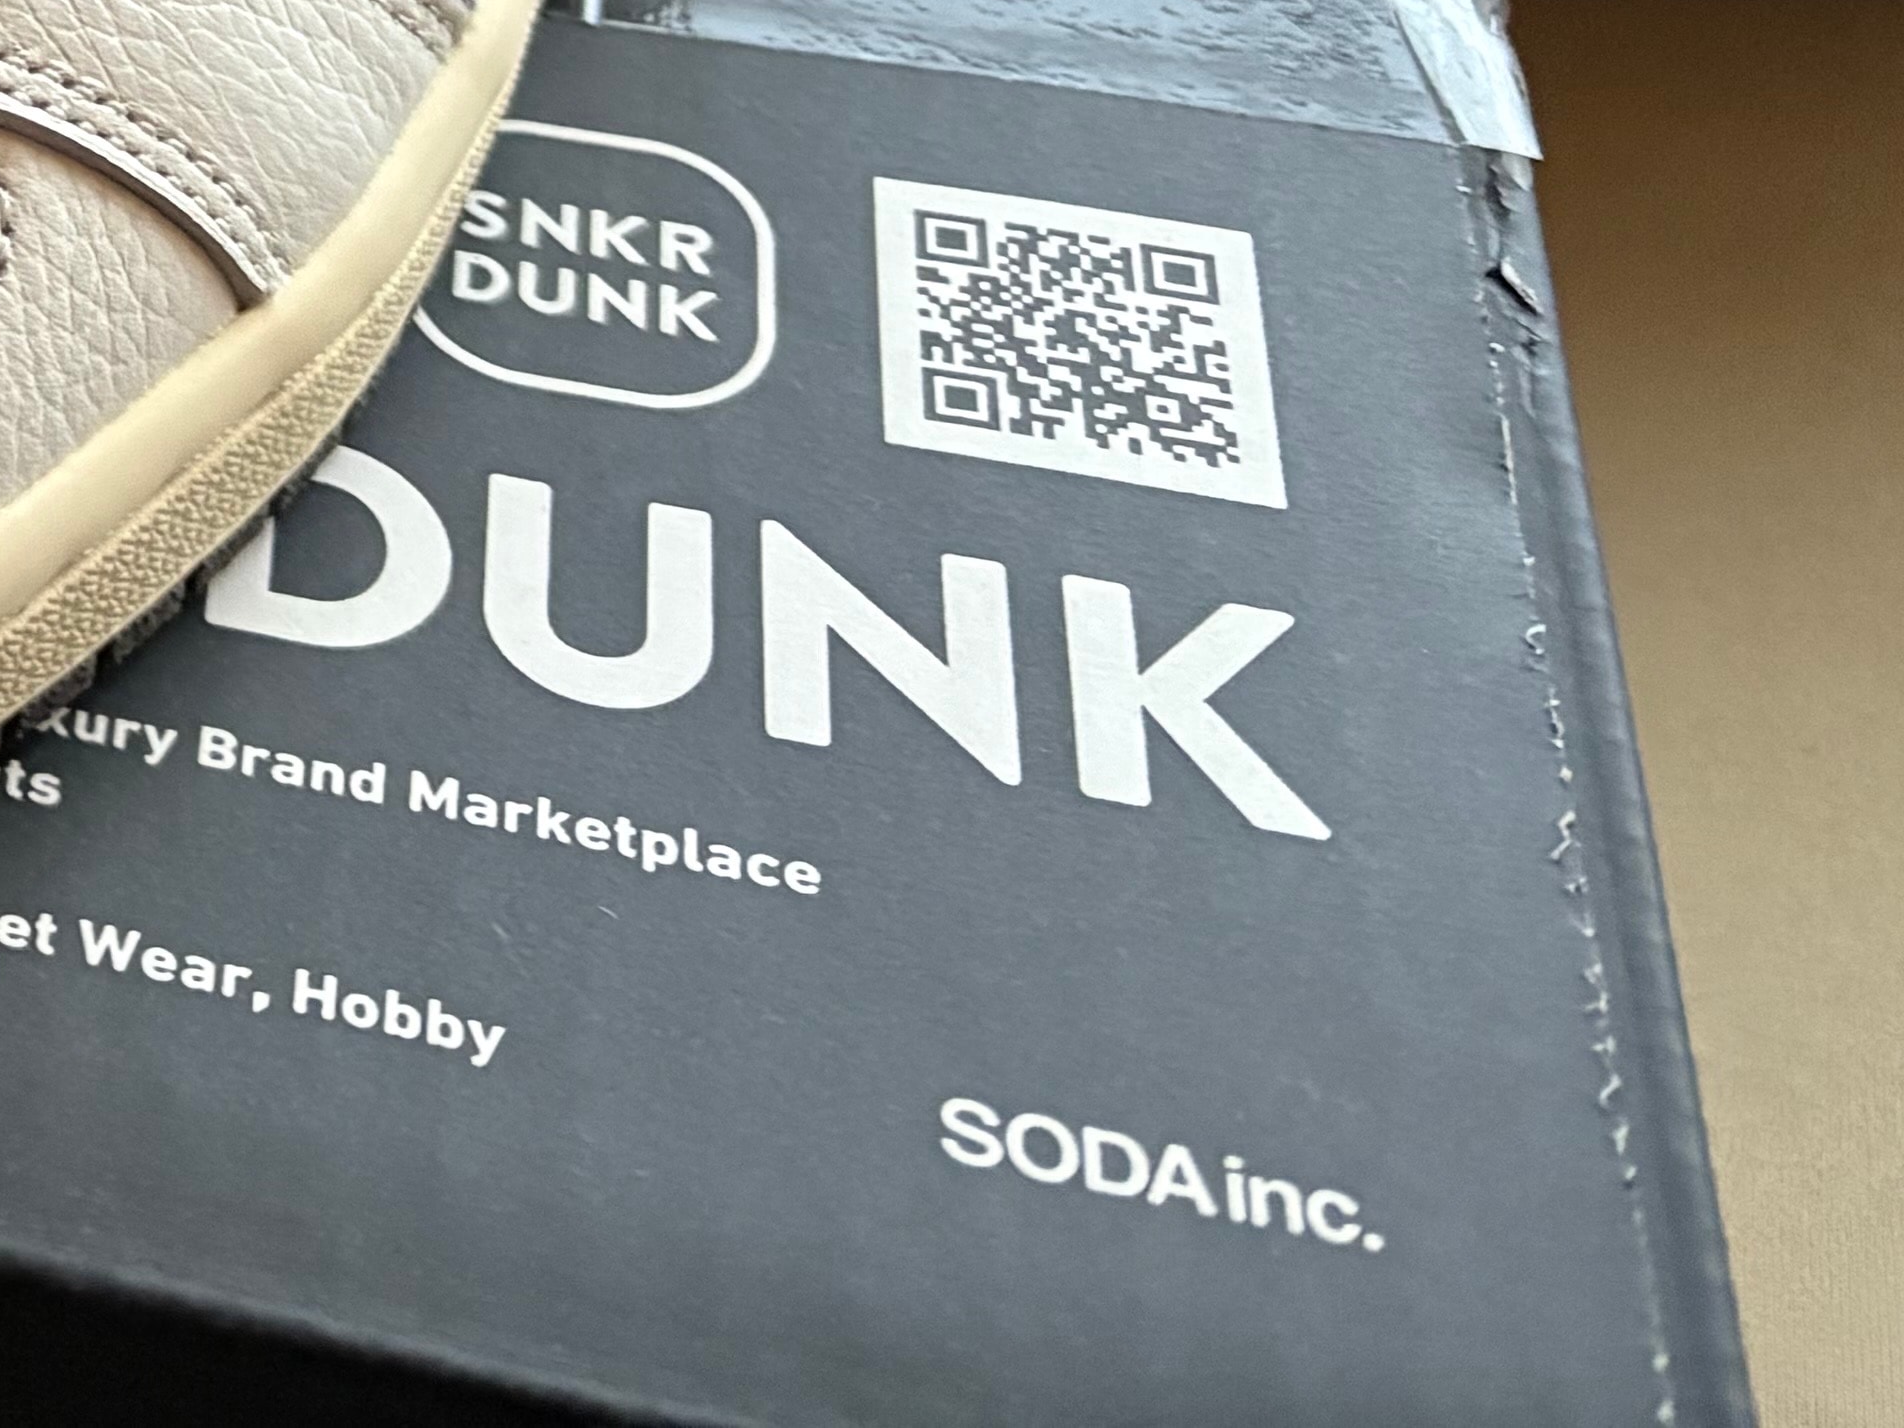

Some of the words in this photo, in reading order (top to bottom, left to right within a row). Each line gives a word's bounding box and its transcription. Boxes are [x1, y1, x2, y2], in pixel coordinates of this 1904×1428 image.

[459, 190, 714, 277] SNKR
[451, 249, 720, 343] DUNK
[36, 706, 179, 766] xury
[196, 724, 386, 805] Brand
[408, 769, 822, 895] Marketplace
[78, 918, 271, 1013] Wear,
[292, 967, 506, 1068] Hobby
